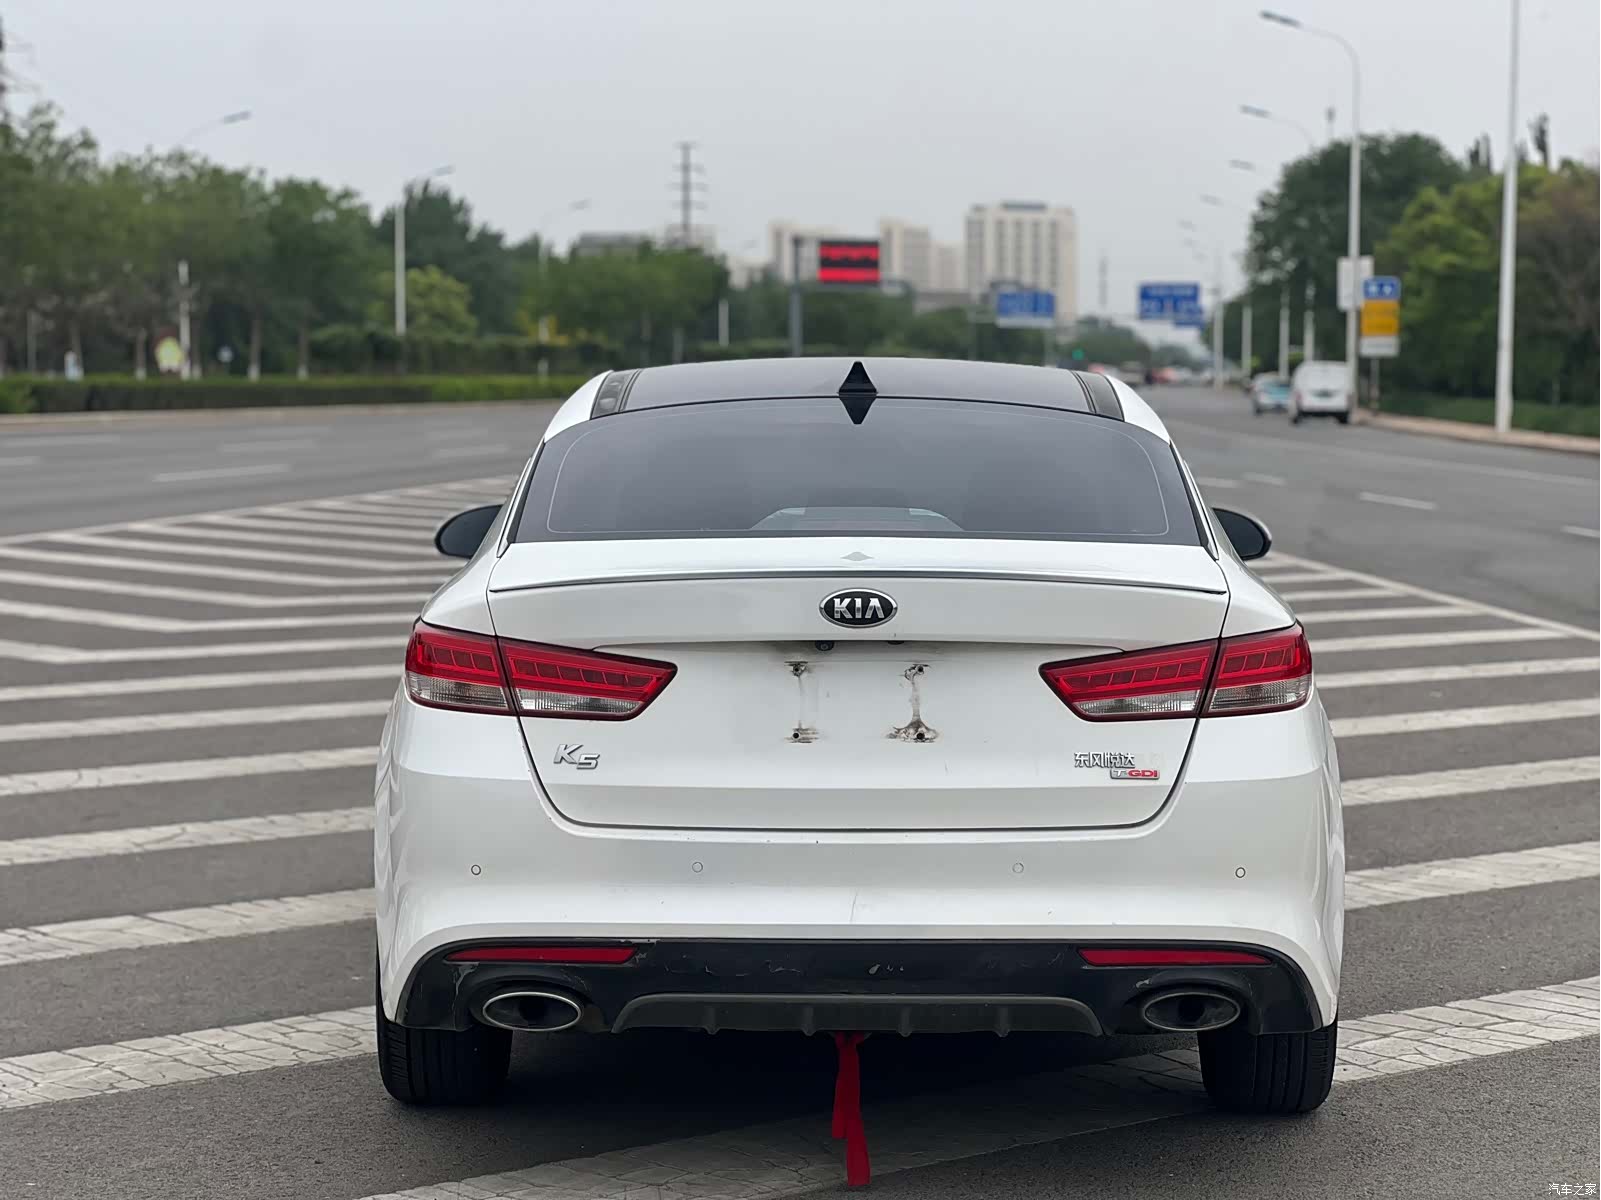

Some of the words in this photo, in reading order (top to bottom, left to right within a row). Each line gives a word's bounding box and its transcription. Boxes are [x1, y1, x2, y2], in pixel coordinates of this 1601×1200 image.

[833, 597, 885, 619] KIA
[553, 743, 601, 770] K5
[1074, 751, 1135, 769] 东风悦达
